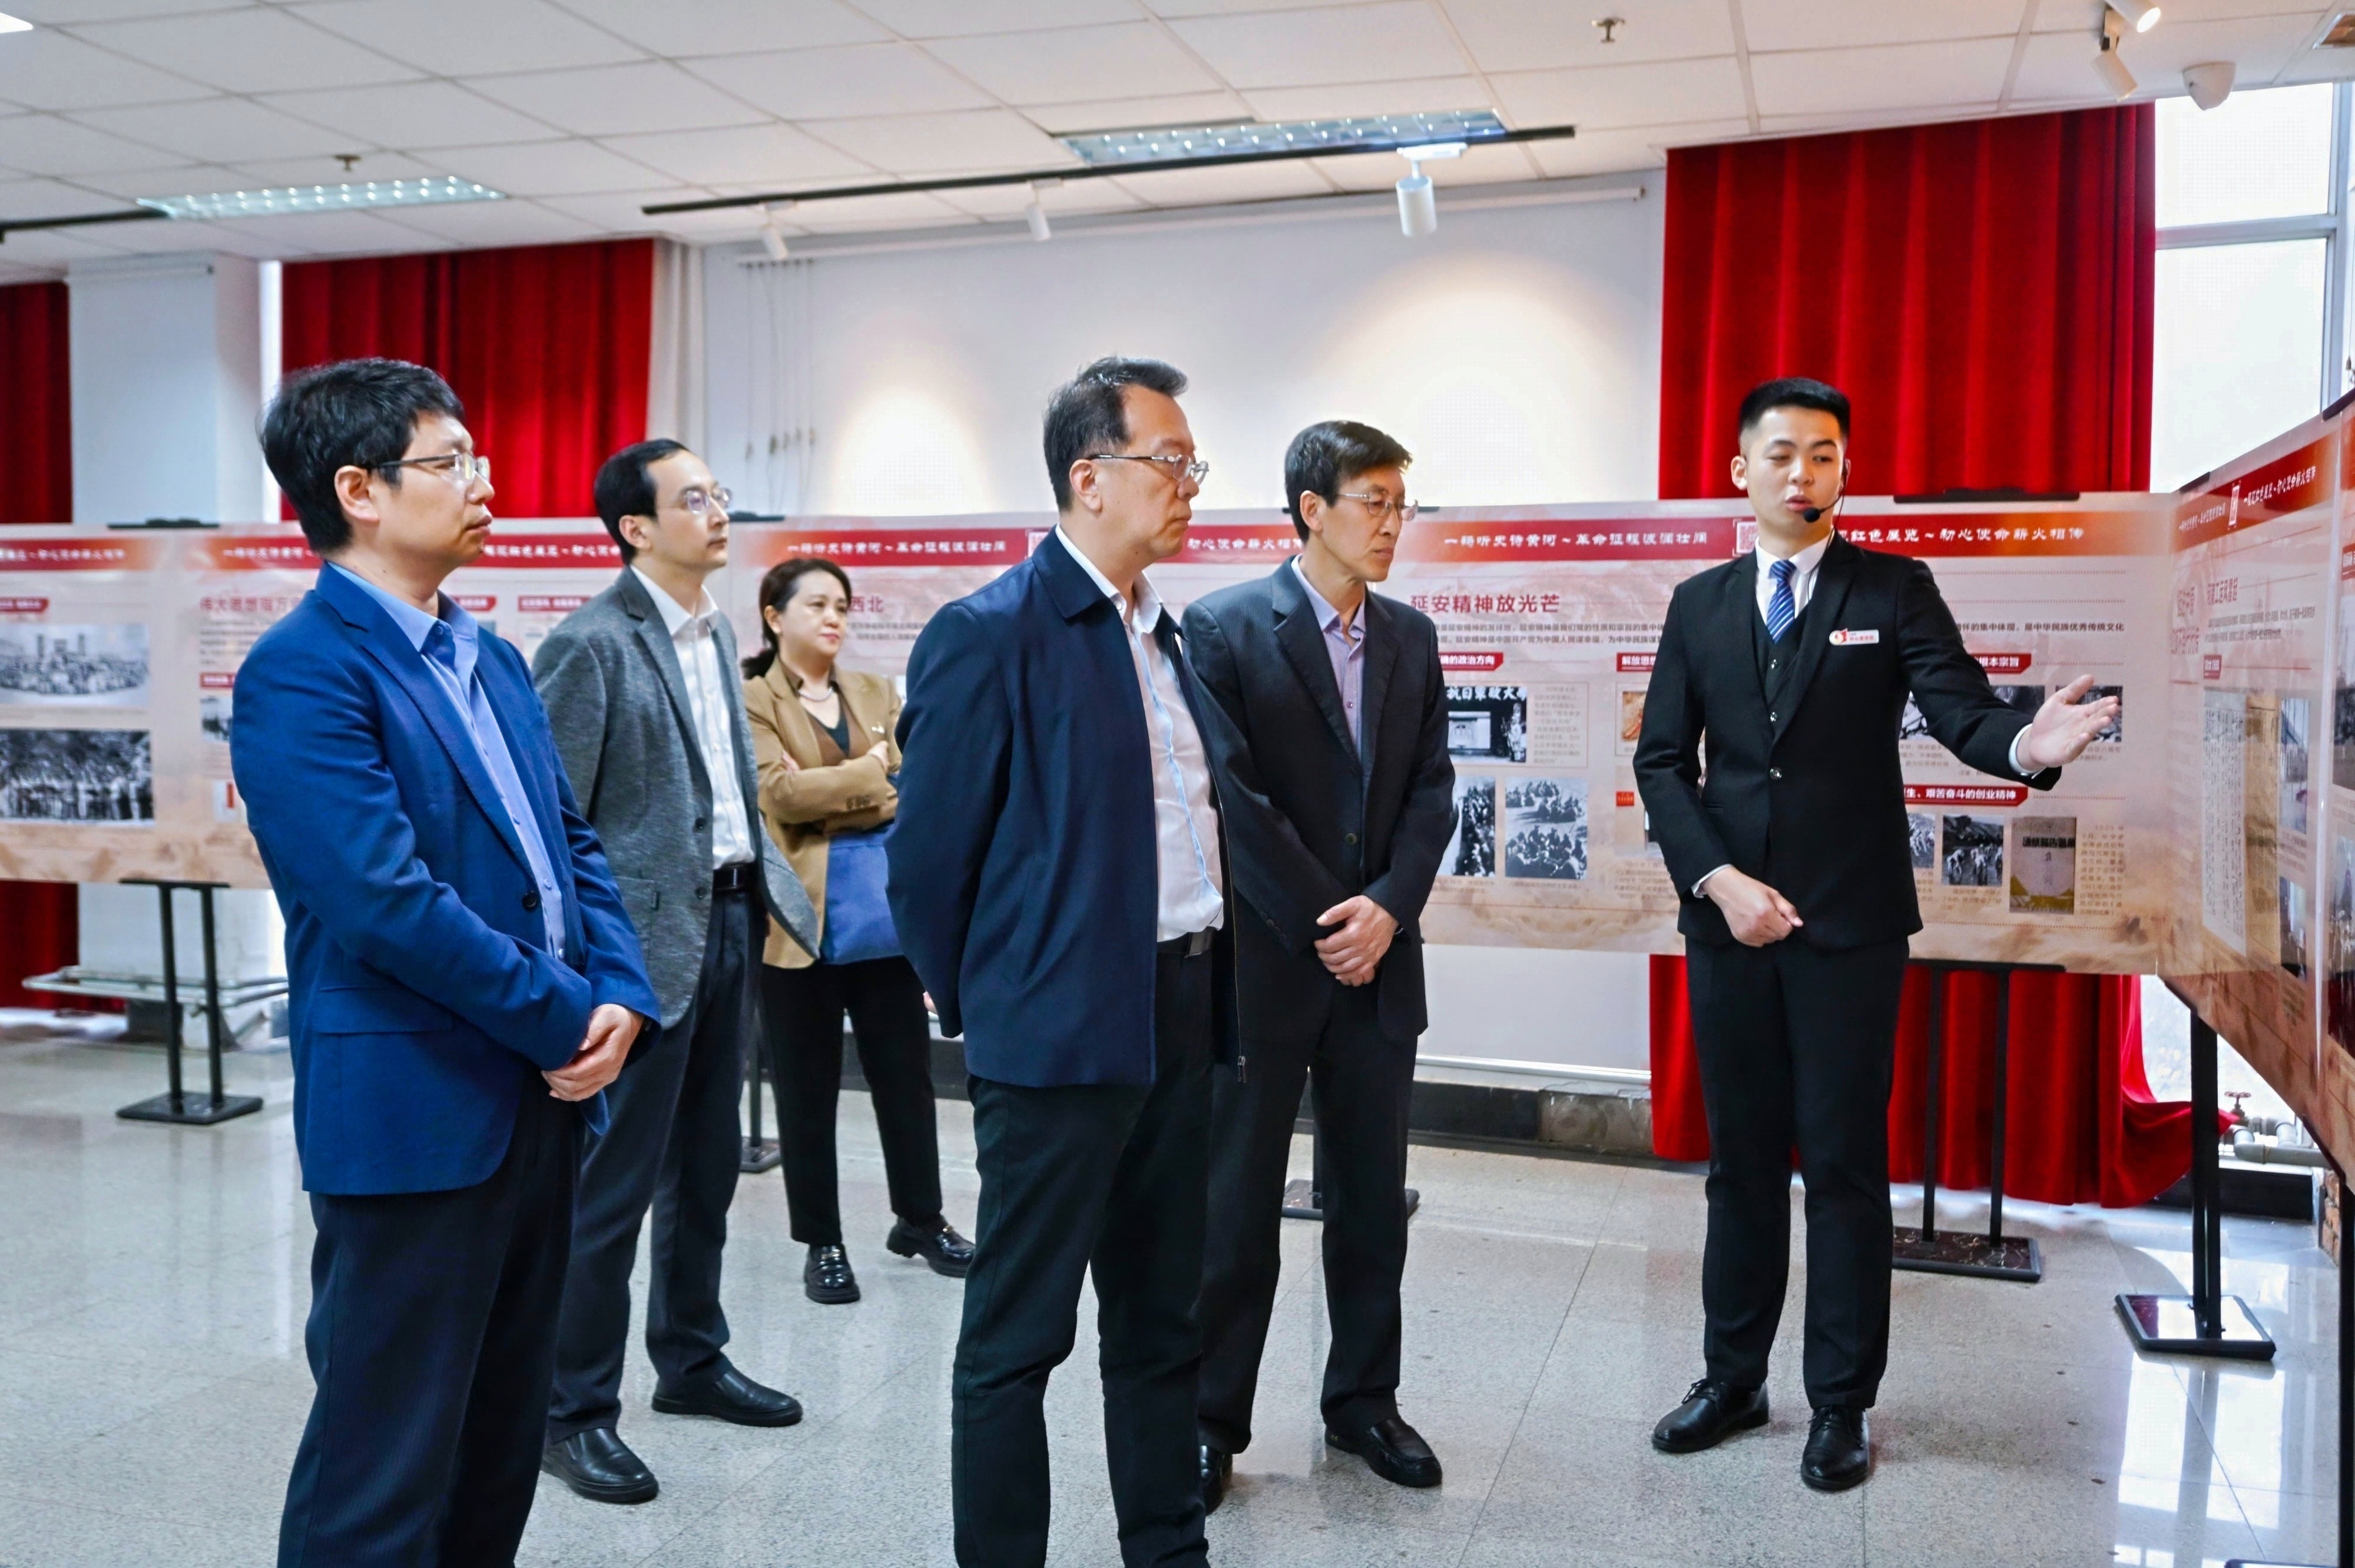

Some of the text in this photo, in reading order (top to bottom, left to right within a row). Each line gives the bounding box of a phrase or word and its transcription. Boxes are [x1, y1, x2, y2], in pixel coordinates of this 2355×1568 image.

[1410, 594, 1560, 614] 延安精神放光芒
[1439, 655, 1495, 665] 确的政治方向
[1974, 656, 2019, 668] 根本宗旨
[1904, 787, 2016, 800] 生、艰苦奋斗的创业精神
